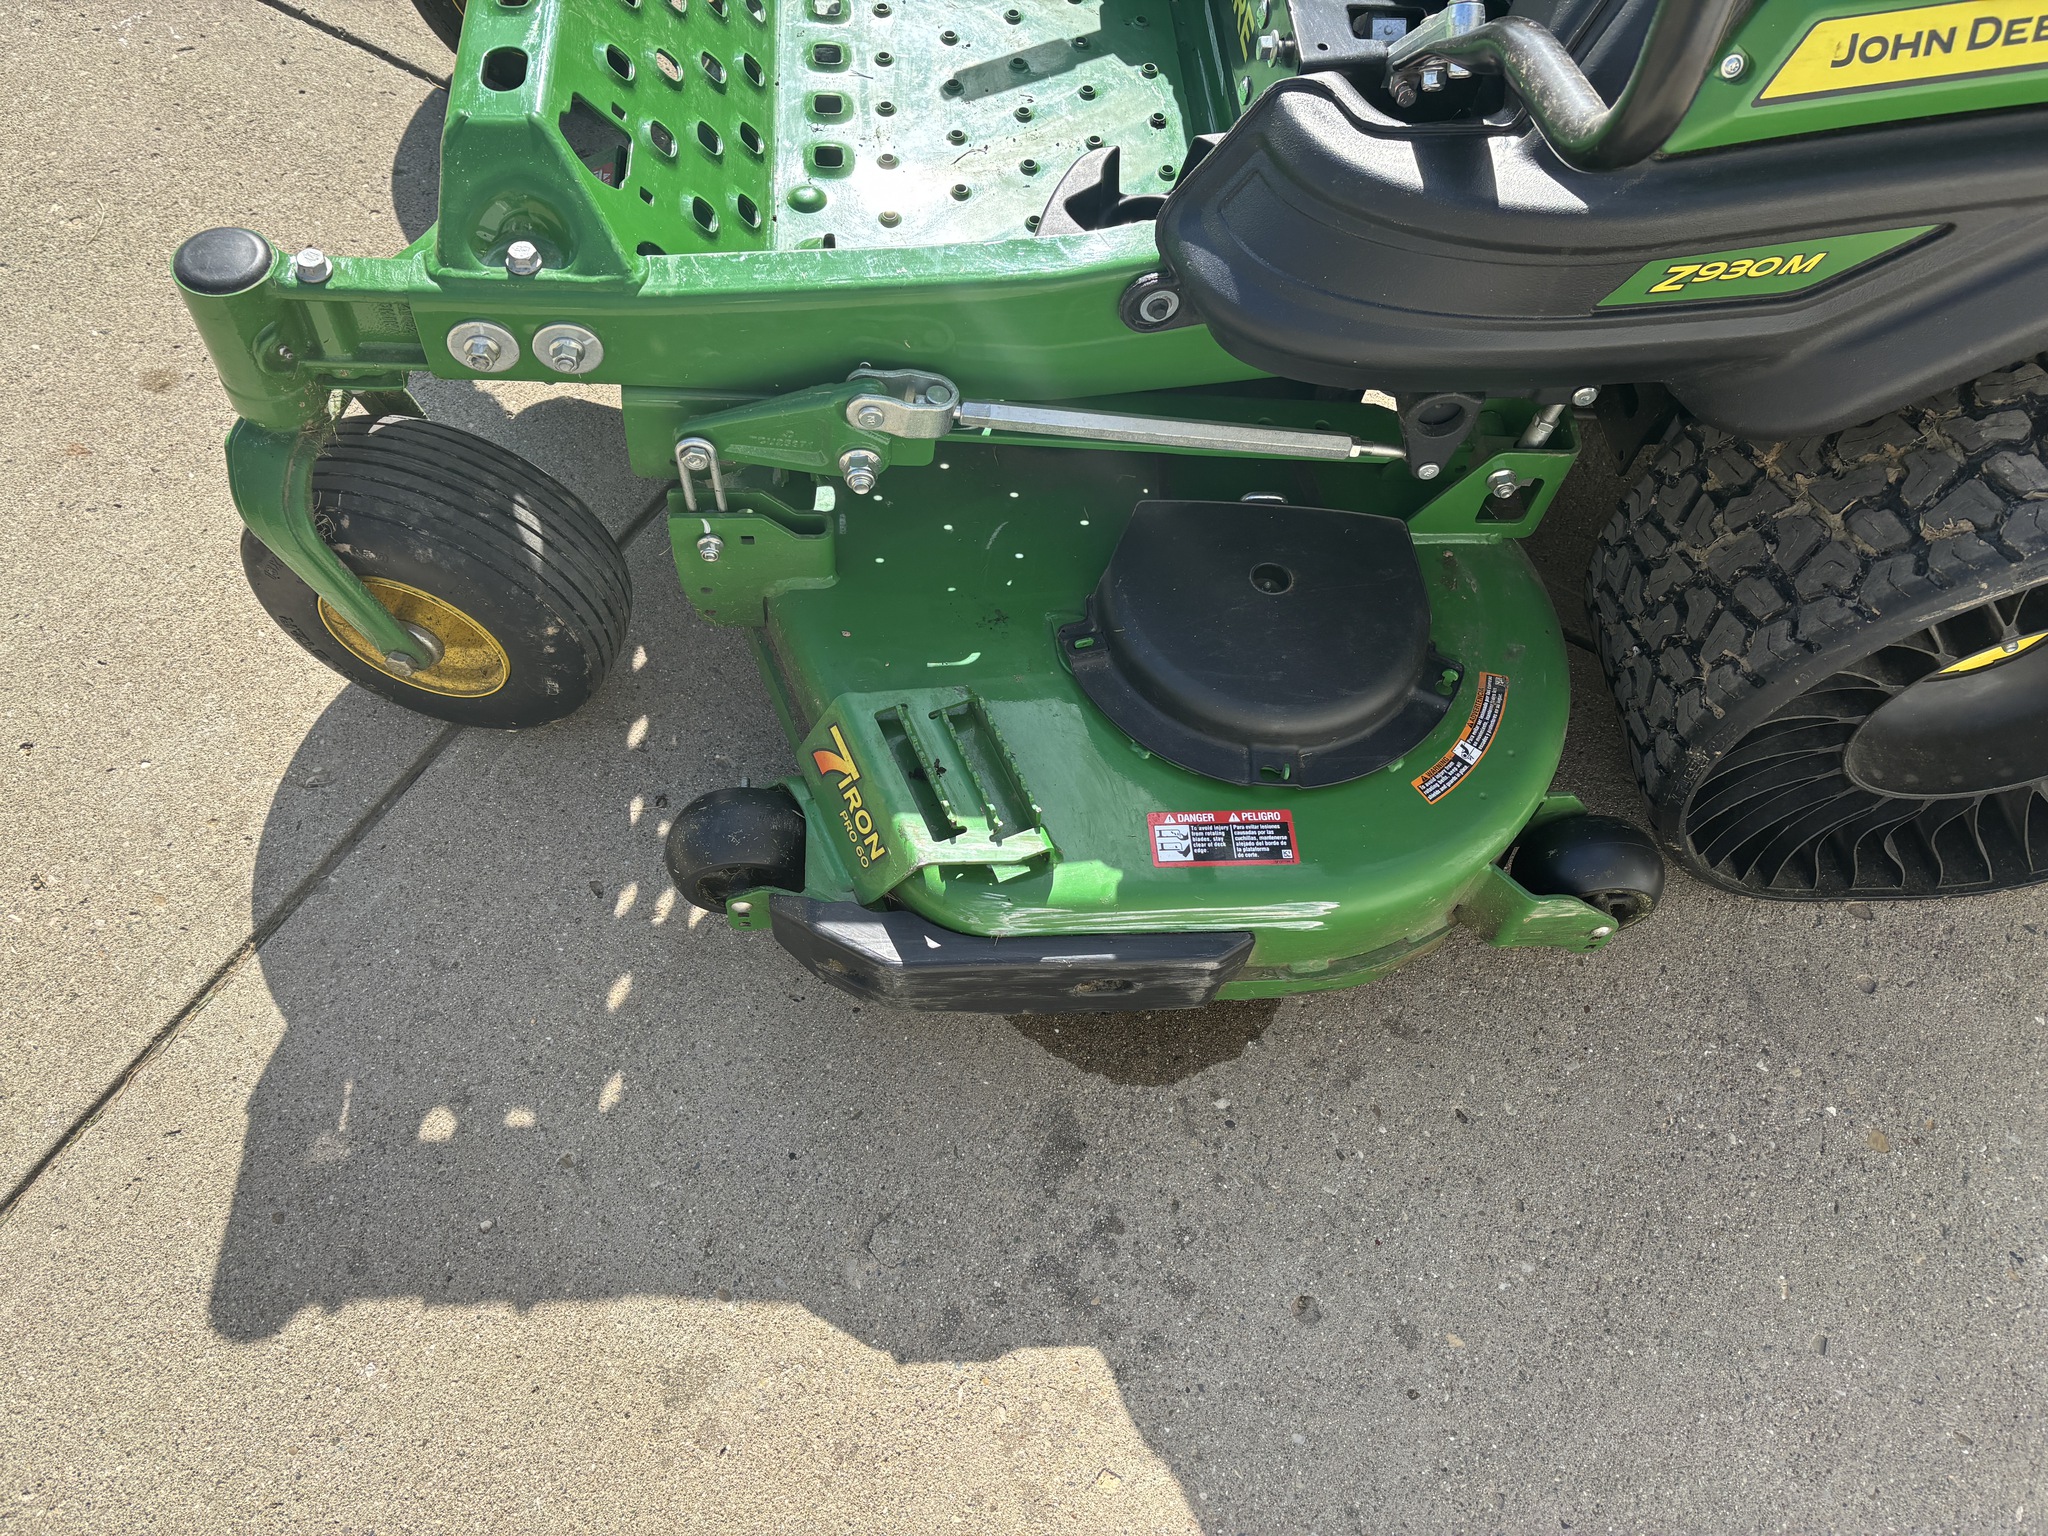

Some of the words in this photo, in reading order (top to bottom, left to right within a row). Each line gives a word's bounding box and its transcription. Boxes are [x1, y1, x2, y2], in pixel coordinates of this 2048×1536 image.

[1830, 26, 1957, 69] JOHN
[1647, 251, 1829, 294] Z930M
[1425, 756, 1450, 777] WARNING
[1177, 813, 1215, 822] DANGER
[1241, 812, 1281, 821] PELIGRO
[840, 810, 858, 843] PRO
[855, 846, 869, 868] 60
